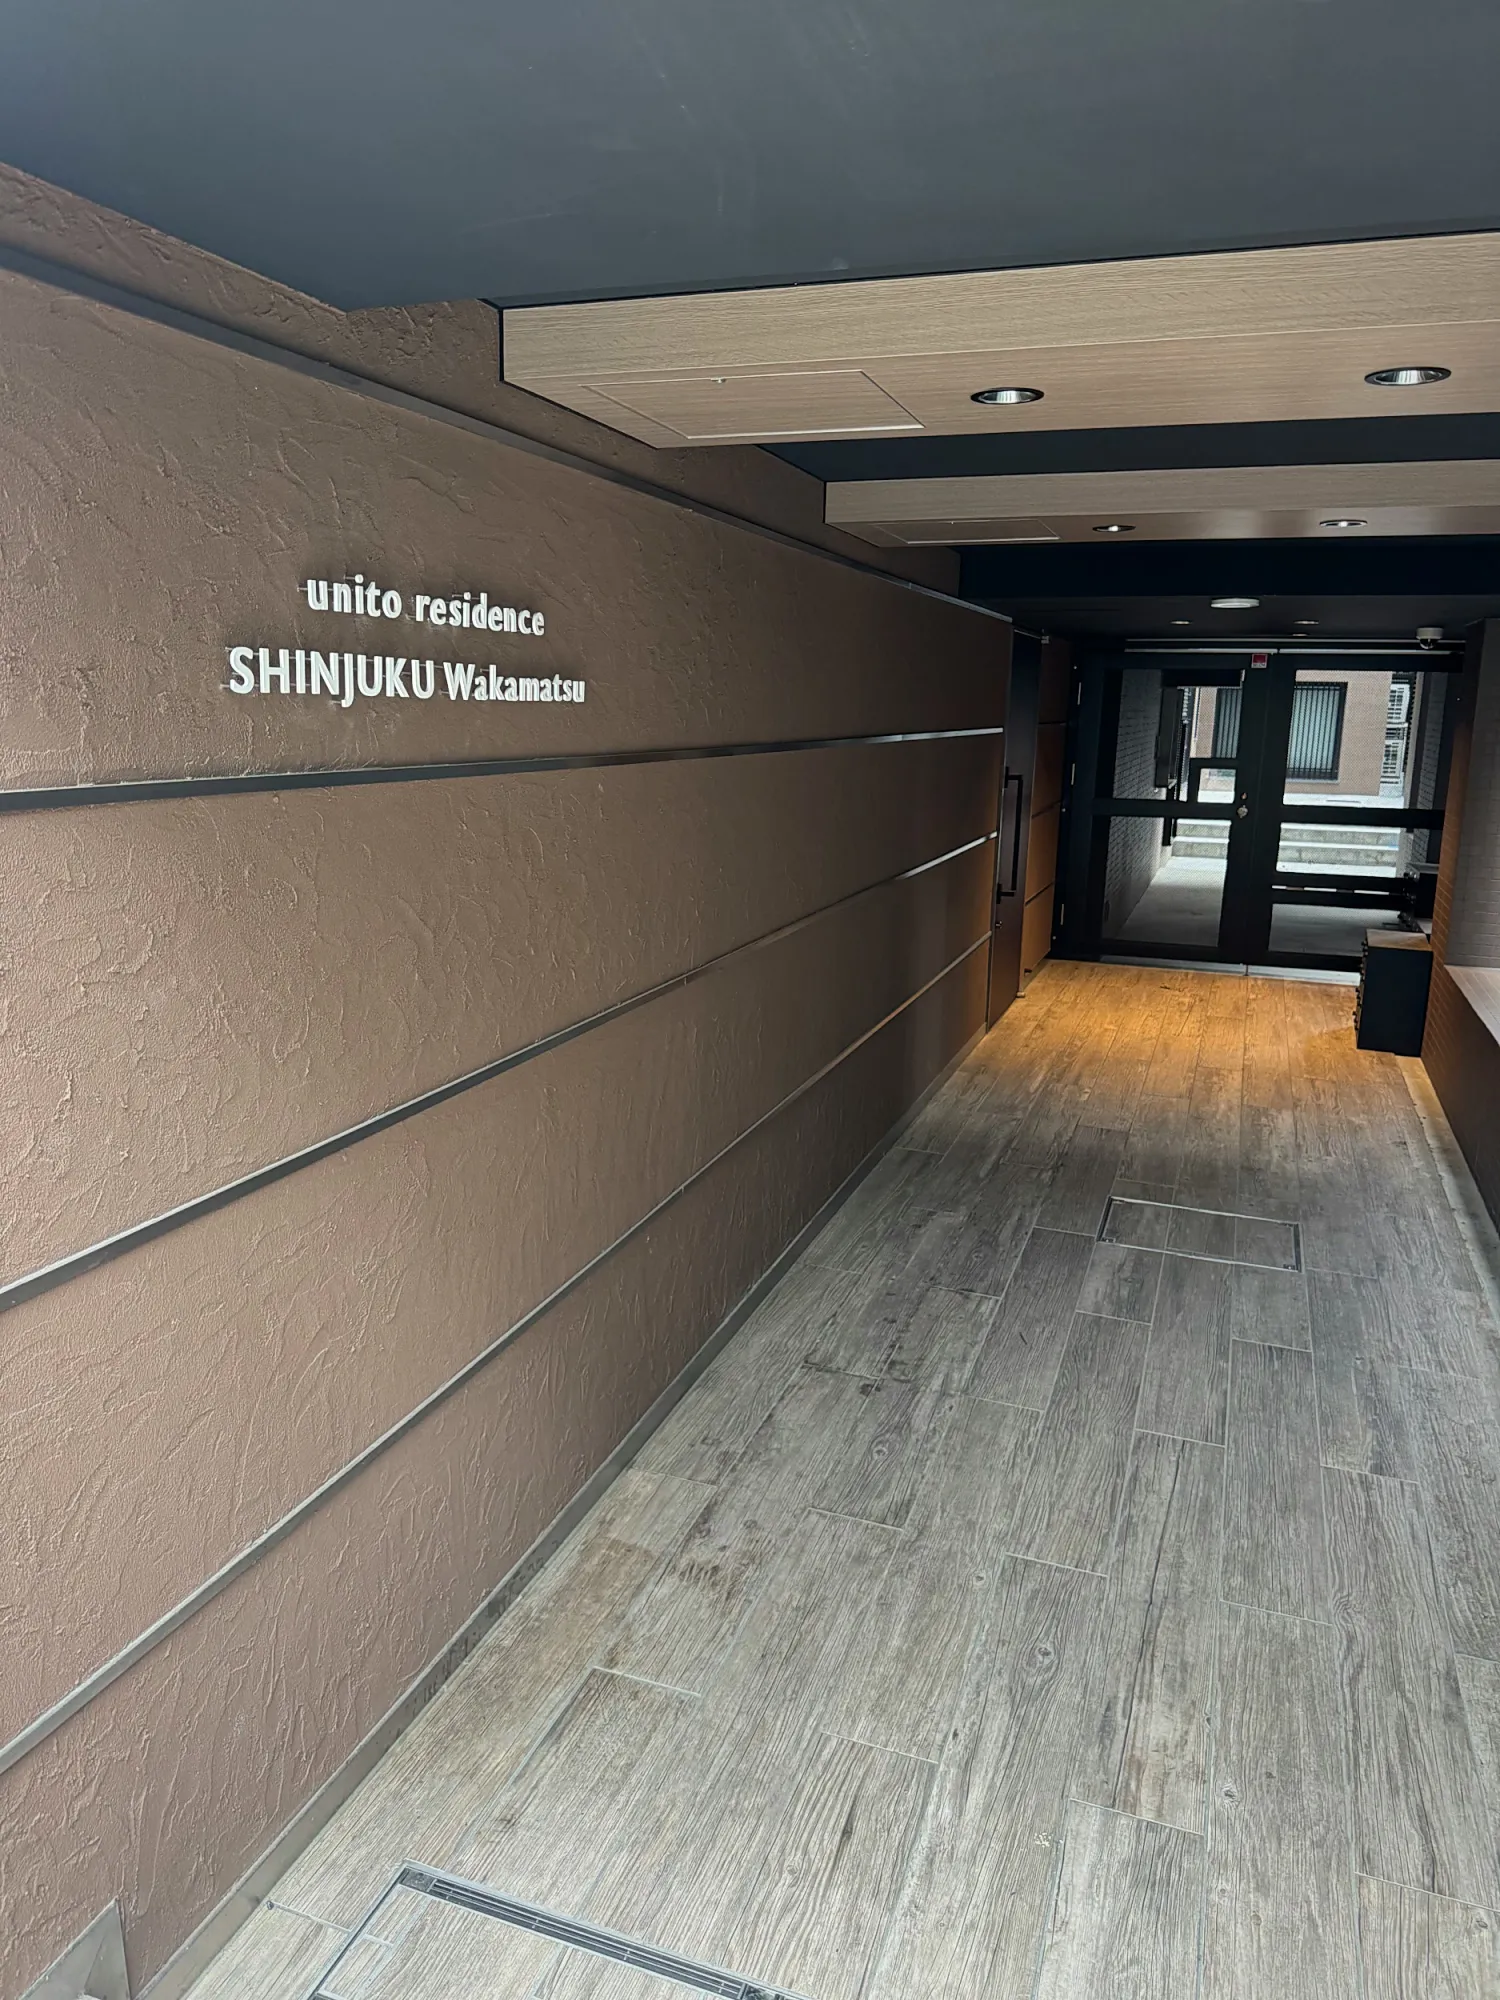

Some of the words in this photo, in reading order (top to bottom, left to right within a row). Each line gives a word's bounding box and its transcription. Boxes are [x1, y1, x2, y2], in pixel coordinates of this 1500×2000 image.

[306, 574, 402, 619] unito
[415, 592, 545, 636] residence
[229, 646, 435, 708] SHINJUKU
[443, 661, 586, 703] Wakamatsu
